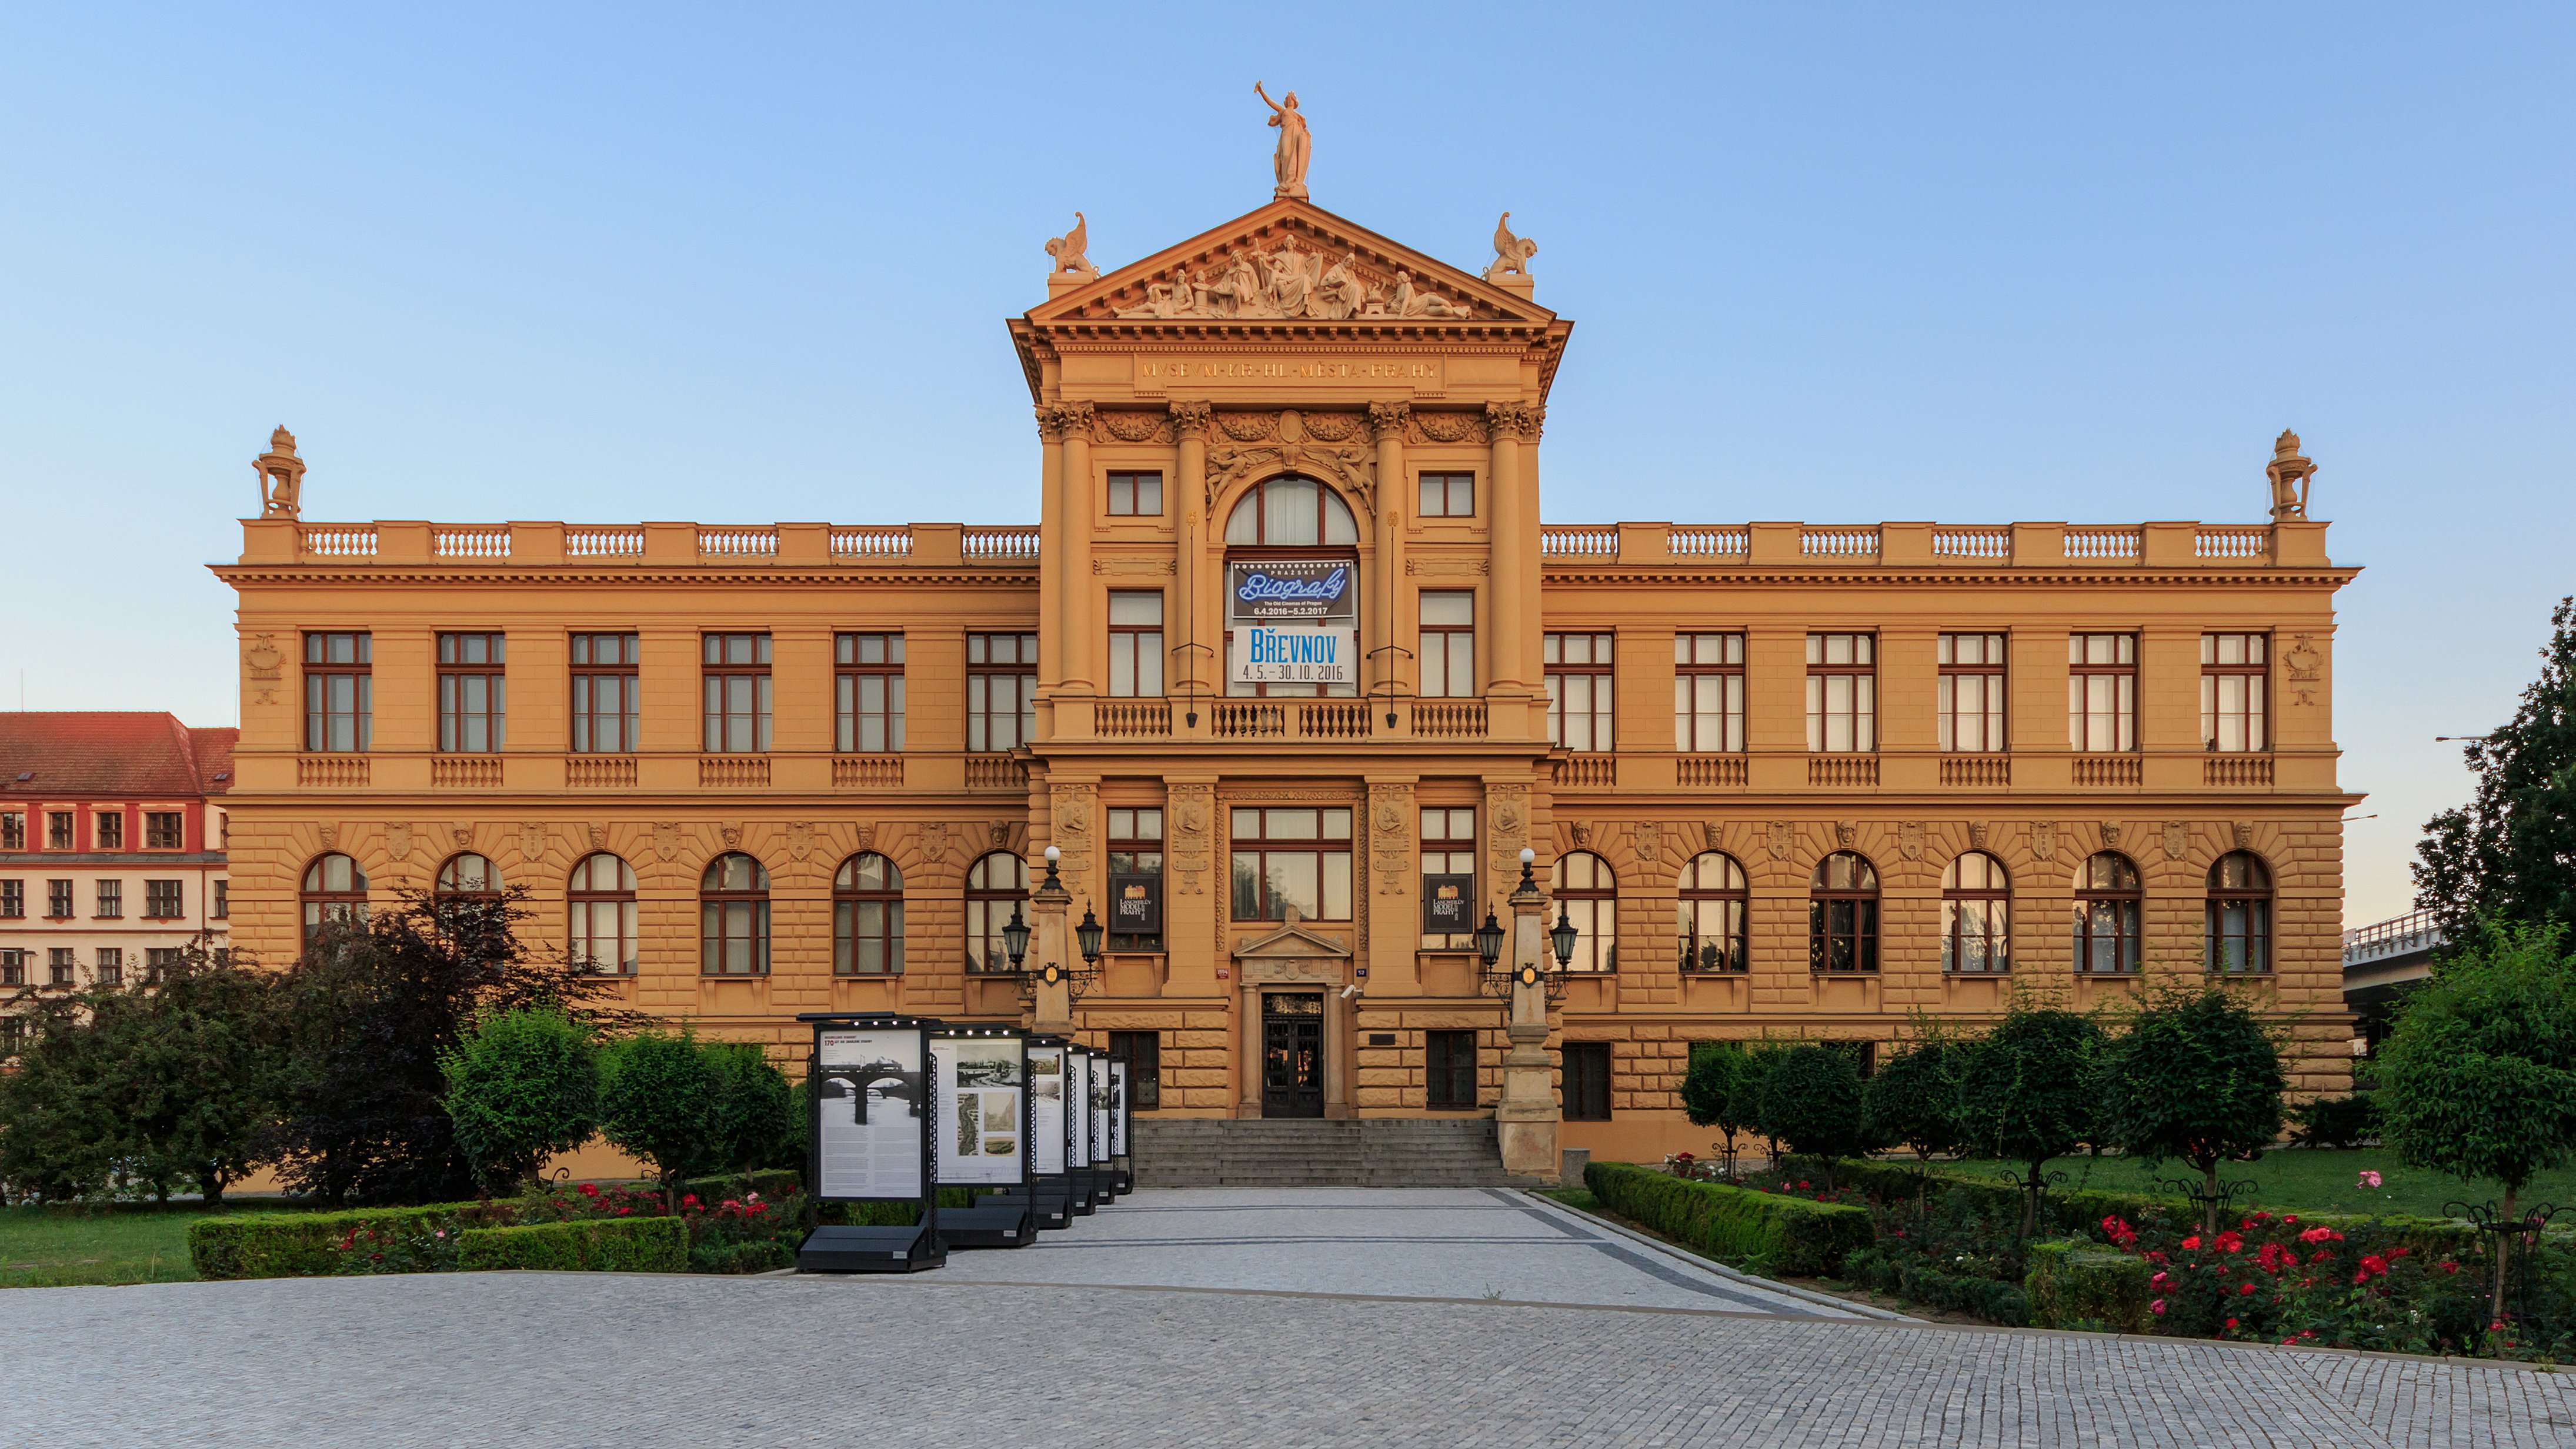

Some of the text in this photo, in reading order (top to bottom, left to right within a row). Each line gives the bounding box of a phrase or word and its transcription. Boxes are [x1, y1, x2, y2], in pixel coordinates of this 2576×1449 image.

[1239, 568, 1346, 600] Biografy
[1250, 628, 1337, 664] BŘEVNOV
[1318, 665, 1343, 680] 2016
